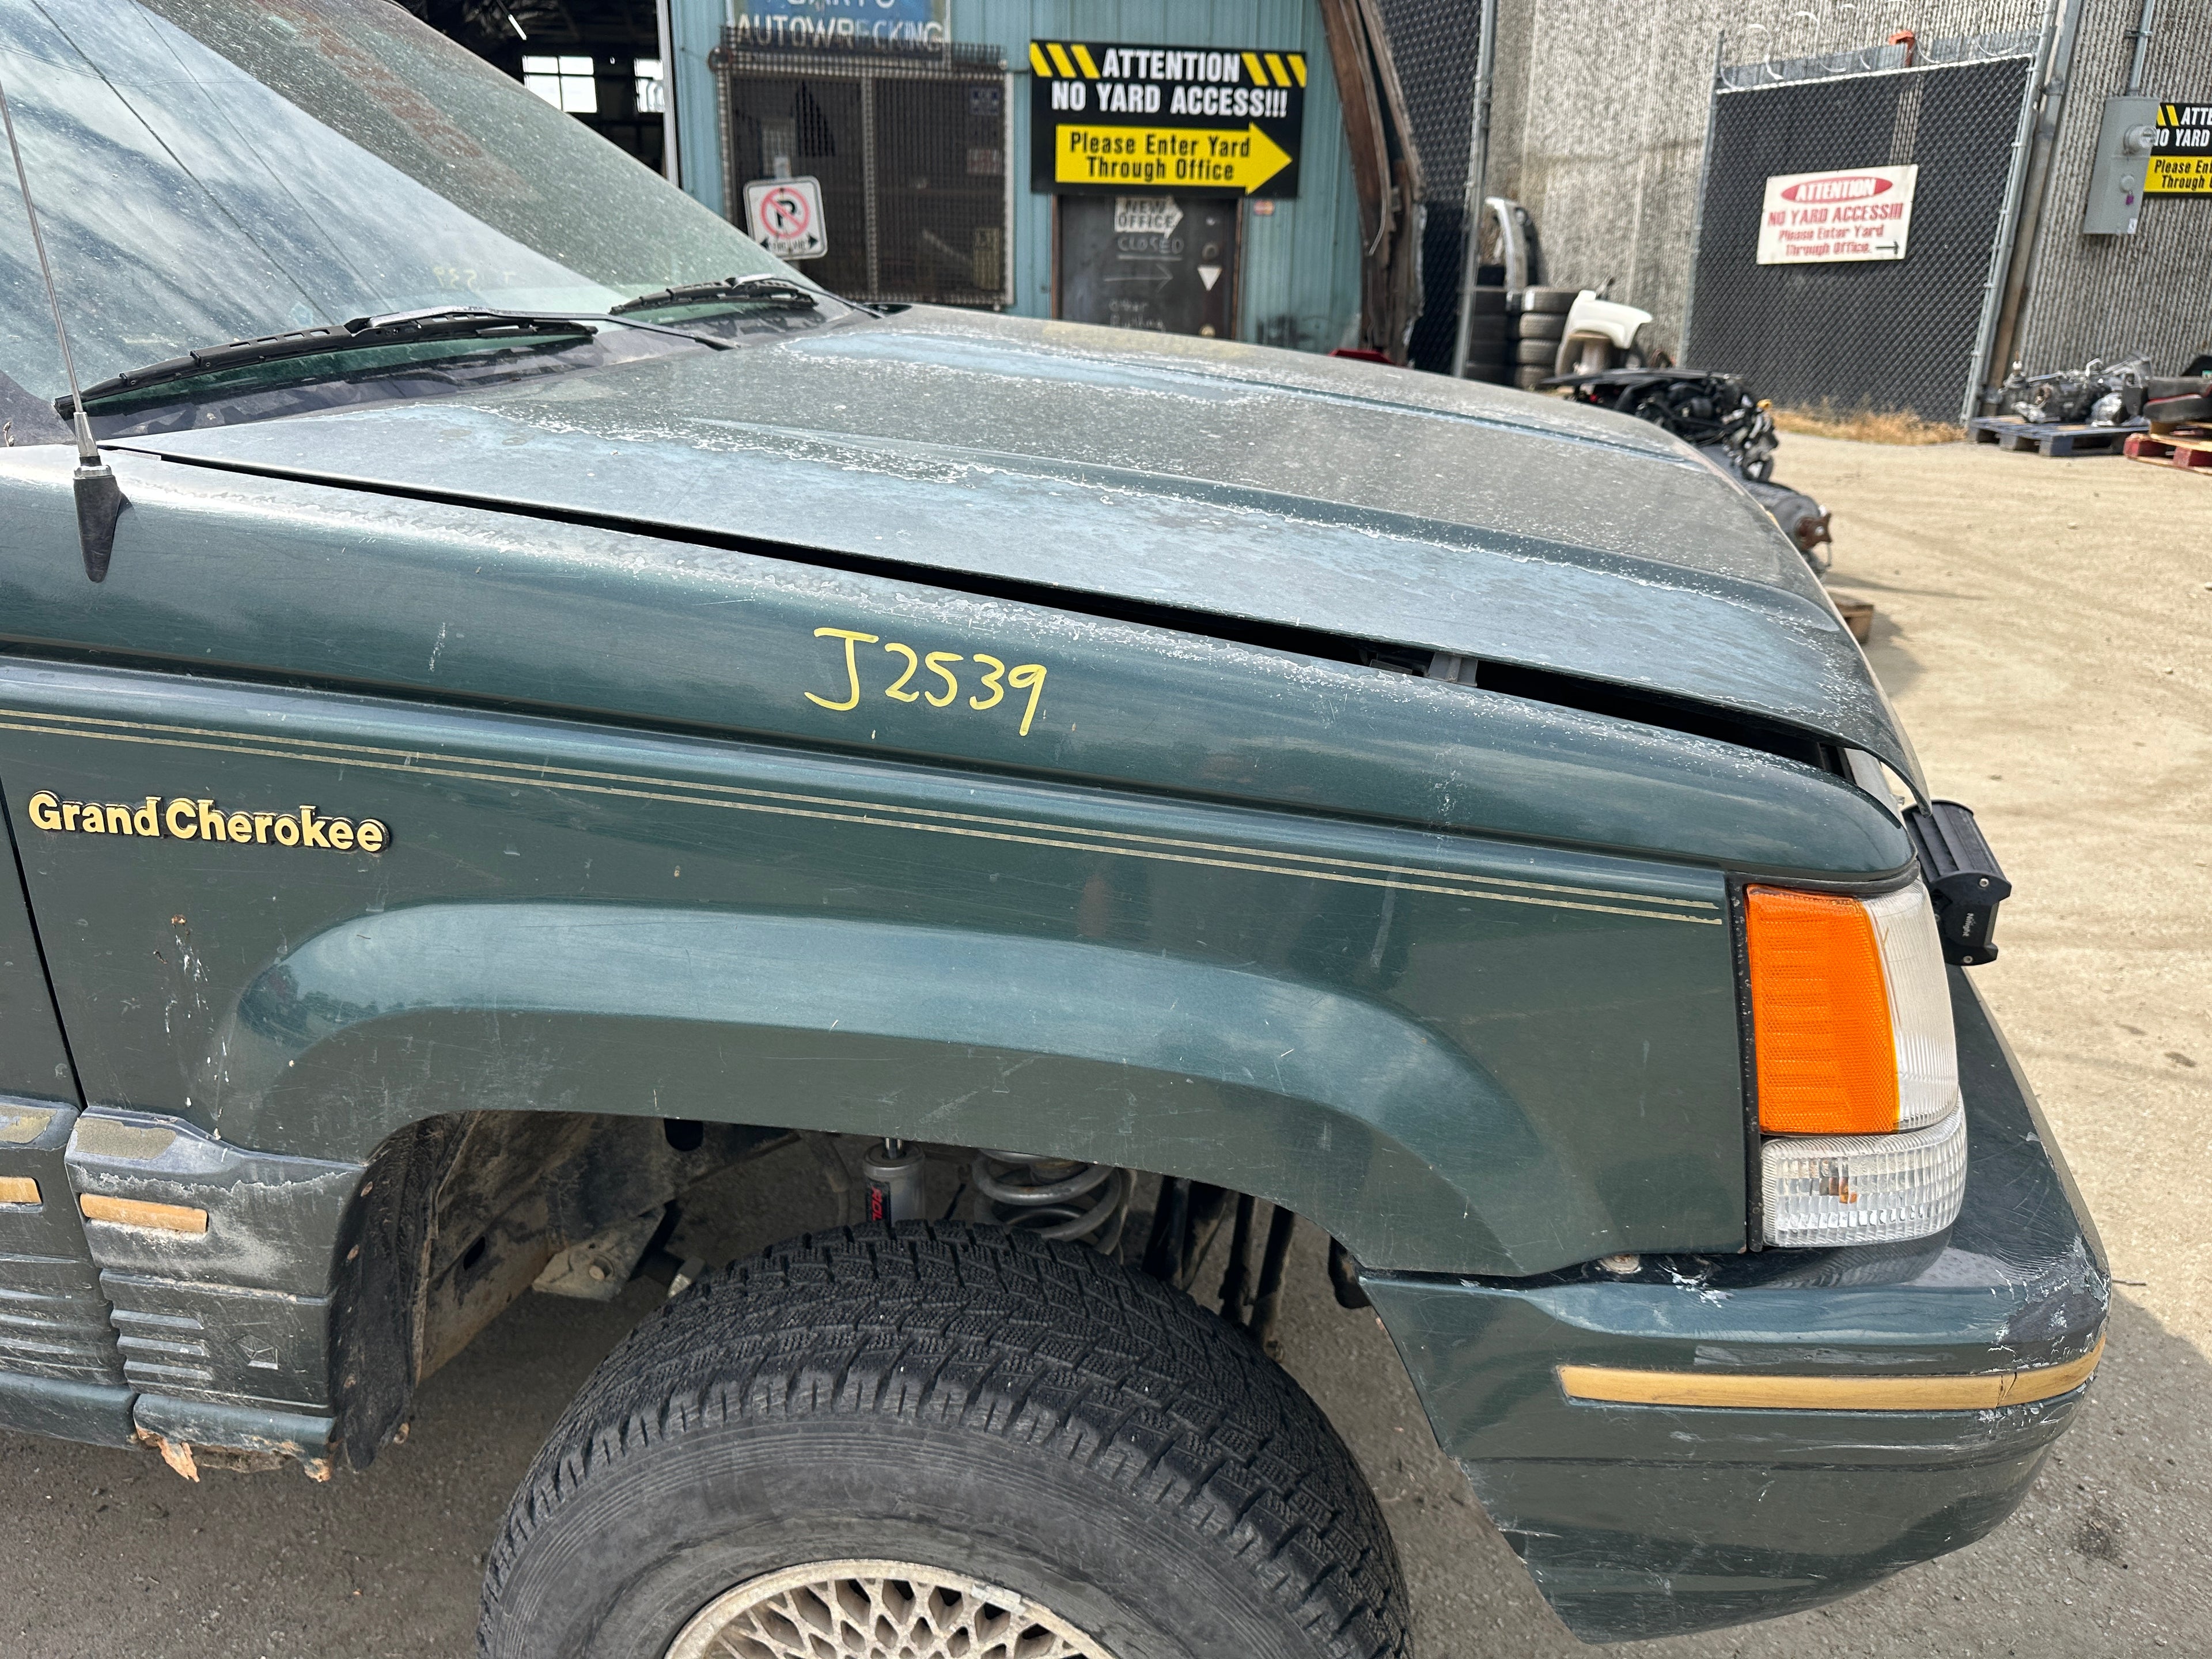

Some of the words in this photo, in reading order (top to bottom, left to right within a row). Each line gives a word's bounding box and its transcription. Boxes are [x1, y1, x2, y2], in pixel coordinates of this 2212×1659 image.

[1101, 48, 1241, 83] ATTENTION
[1051, 81, 1087, 111] NO
[1096, 83, 1161, 113] YARD
[1170, 86, 1288, 118] ACCESS!!!
[1070, 131, 1135, 154] Please
[1145, 134, 1199, 157] Enter
[1208, 136, 1250, 158] Yard
[2175, 128, 2210, 147] YARD
[1087, 156, 1166, 181] Through
[1176, 160, 1234, 181] Office
[2154, 159, 2191, 173] Please
[1794, 178, 1877, 202] ATTENTION
[2162, 175, 2205, 191] Through
[1126, 200, 1165, 214] NEW
[1119, 213, 1173, 228] OFFICE
[1767, 210, 1786, 226] NO
[1791, 208, 1828, 224] YARD
[1779, 229, 1813, 241] Please
[1817, 226, 1851, 240] Enter
[1854, 224, 1884, 237] Yard
[1118, 235, 1184, 254] CLOSED
[1786, 243, 1830, 257] Through
[804, 627, 1047, 736] J2539
[28, 790, 162, 838] Grand
[166, 797, 389, 854] Cherokee
